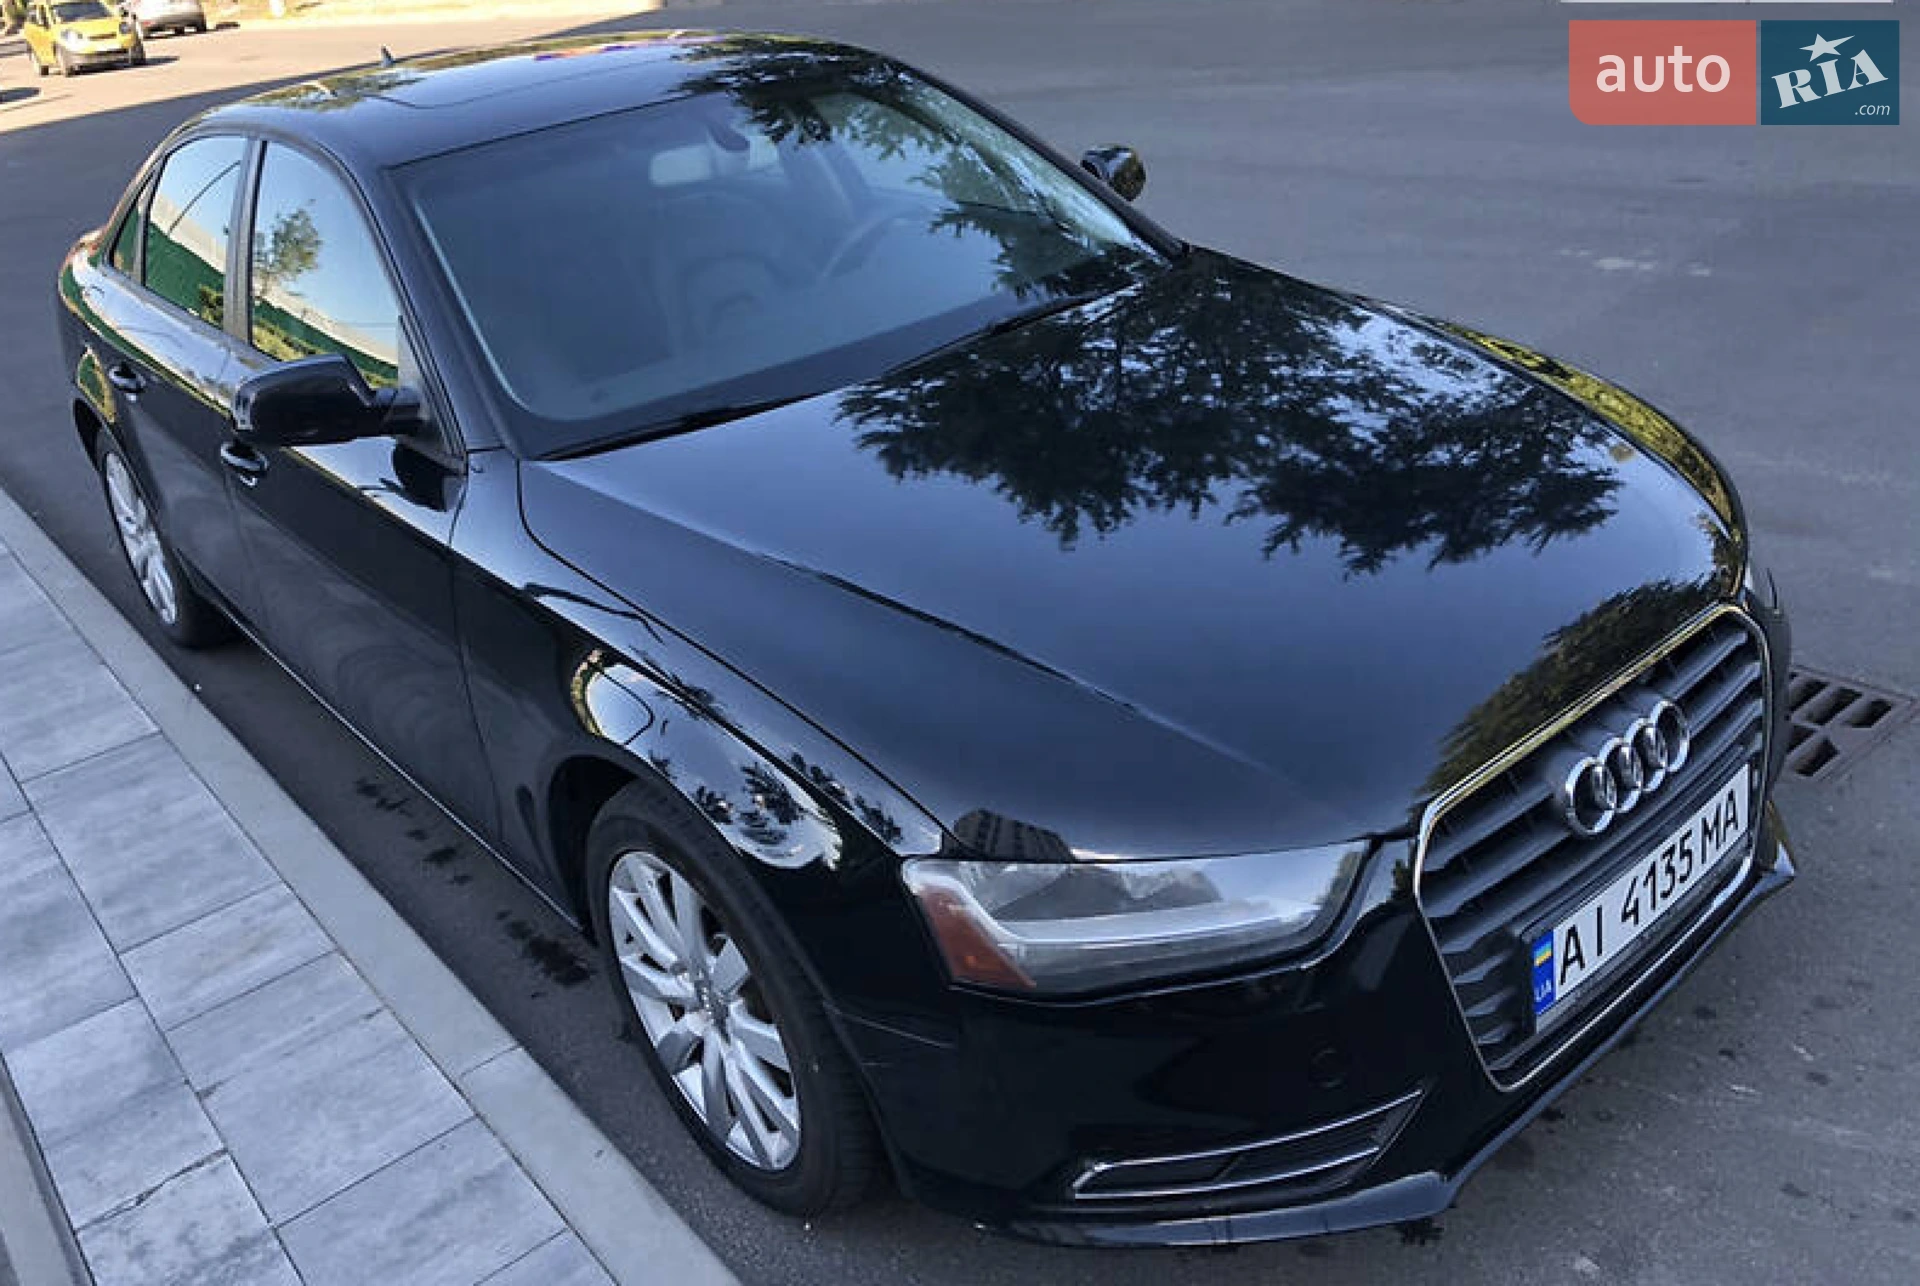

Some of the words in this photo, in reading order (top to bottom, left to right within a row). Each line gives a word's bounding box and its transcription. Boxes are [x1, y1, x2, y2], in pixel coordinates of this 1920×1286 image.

[1620, 829, 1693, 926] 4135
[1701, 788, 1739, 865] MA
[1533, 979, 1553, 1003] UA
